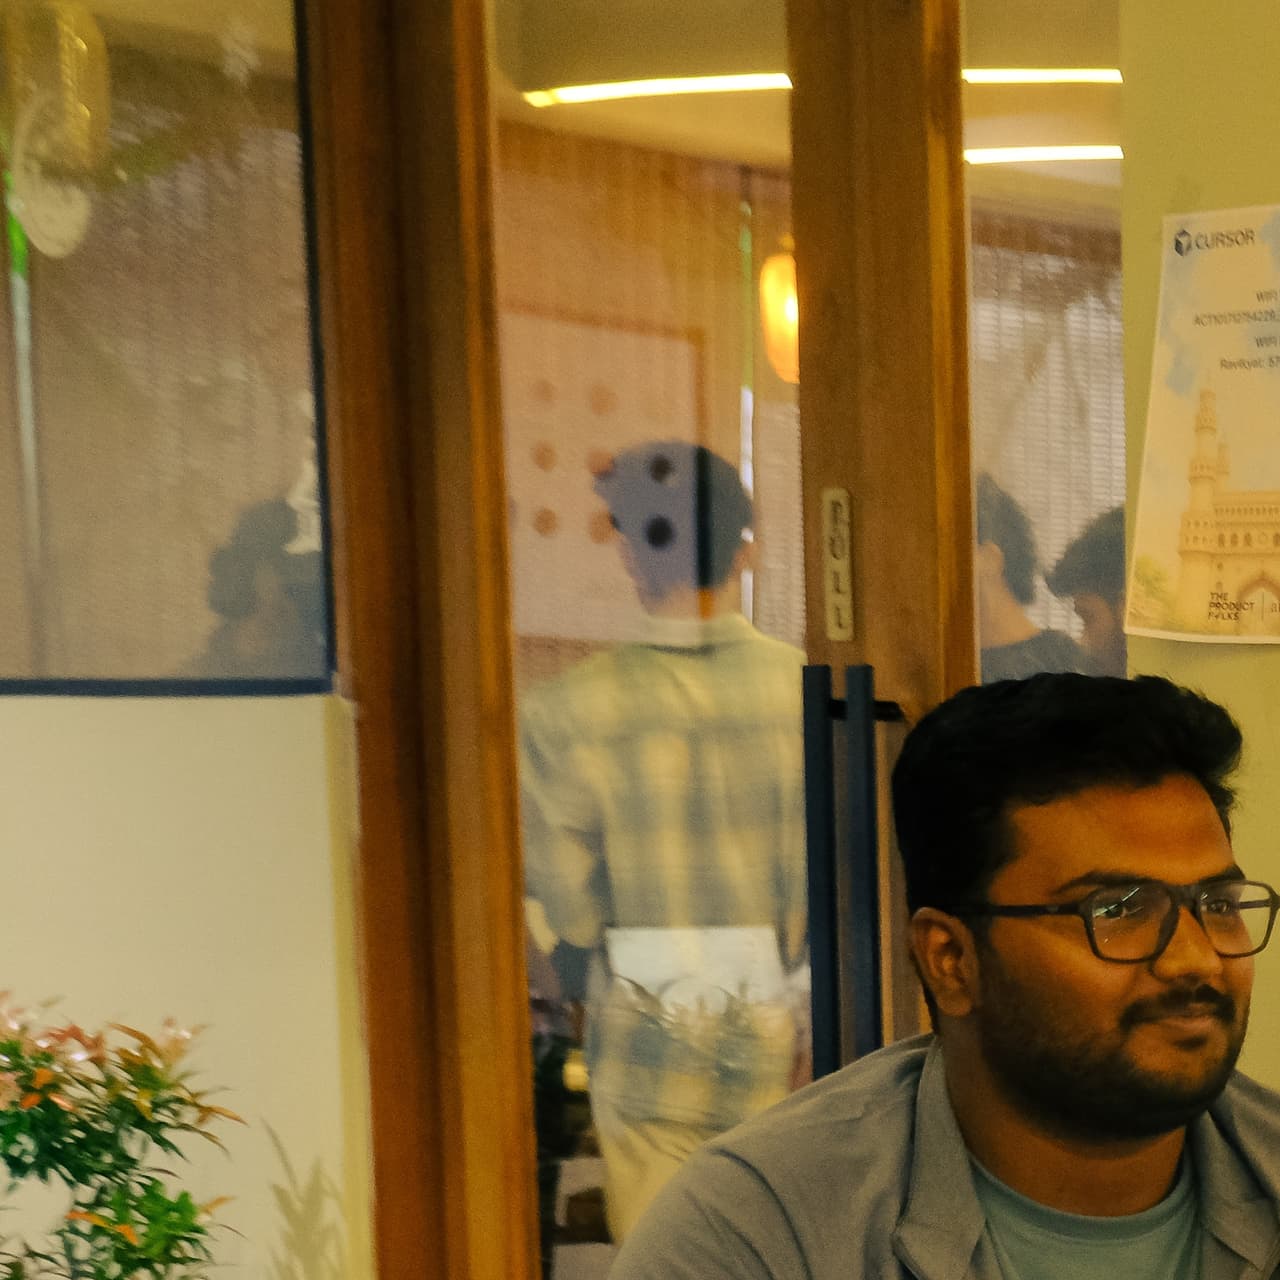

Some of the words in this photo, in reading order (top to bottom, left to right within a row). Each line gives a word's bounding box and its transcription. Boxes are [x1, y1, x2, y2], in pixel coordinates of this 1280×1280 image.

[1195, 229, 1255, 250] CURSOR
[1210, 592, 1228, 601] THE
[1208, 601, 1255, 612] PRODUCT
